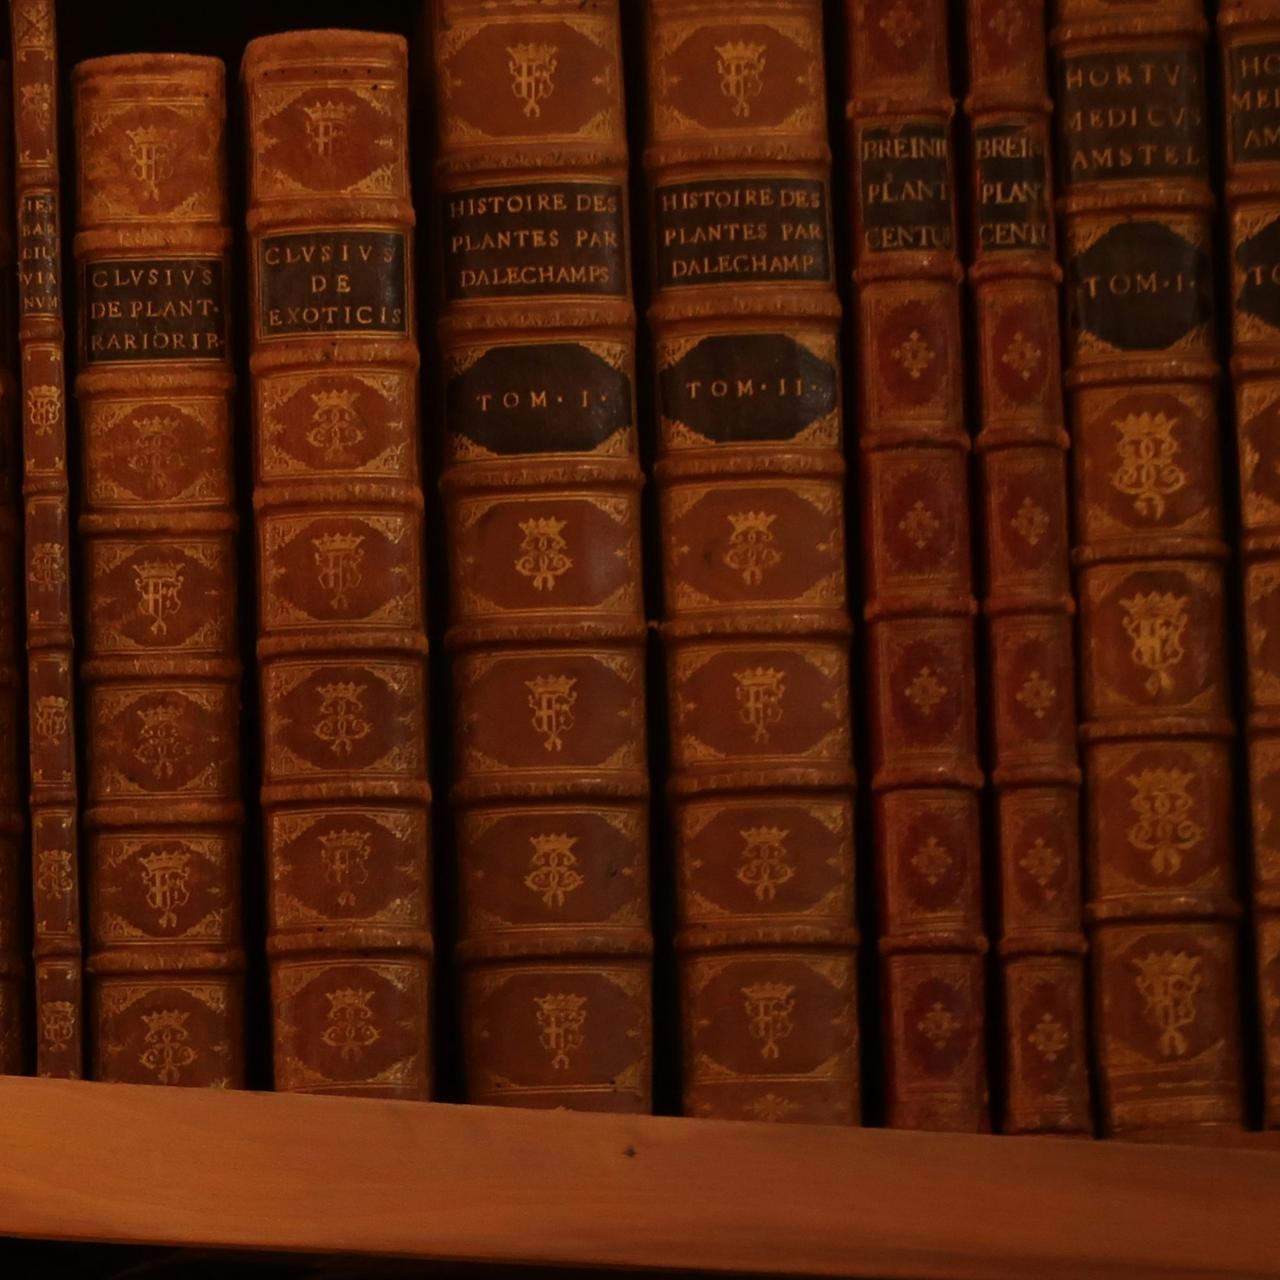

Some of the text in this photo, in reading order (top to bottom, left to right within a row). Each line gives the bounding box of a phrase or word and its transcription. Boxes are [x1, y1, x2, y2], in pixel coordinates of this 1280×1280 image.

[448, 194, 617, 219] HISTOIRE DES
[661, 189, 821, 212] HISTOIRE DES
[450, 230, 618, 254] PLANTES PAR
[663, 223, 824, 247] PLANTES PAR
[264, 244, 395, 265] CLVSIVS
[460, 265, 610, 288] DALECHAMPS
[671, 255, 815, 278] DALECHAMP
[91, 269, 214, 289] CLVSIVS
[310, 275, 353, 294] DE
[90, 301, 122, 320] DE
[268, 304, 403, 326] EXOTICIS
